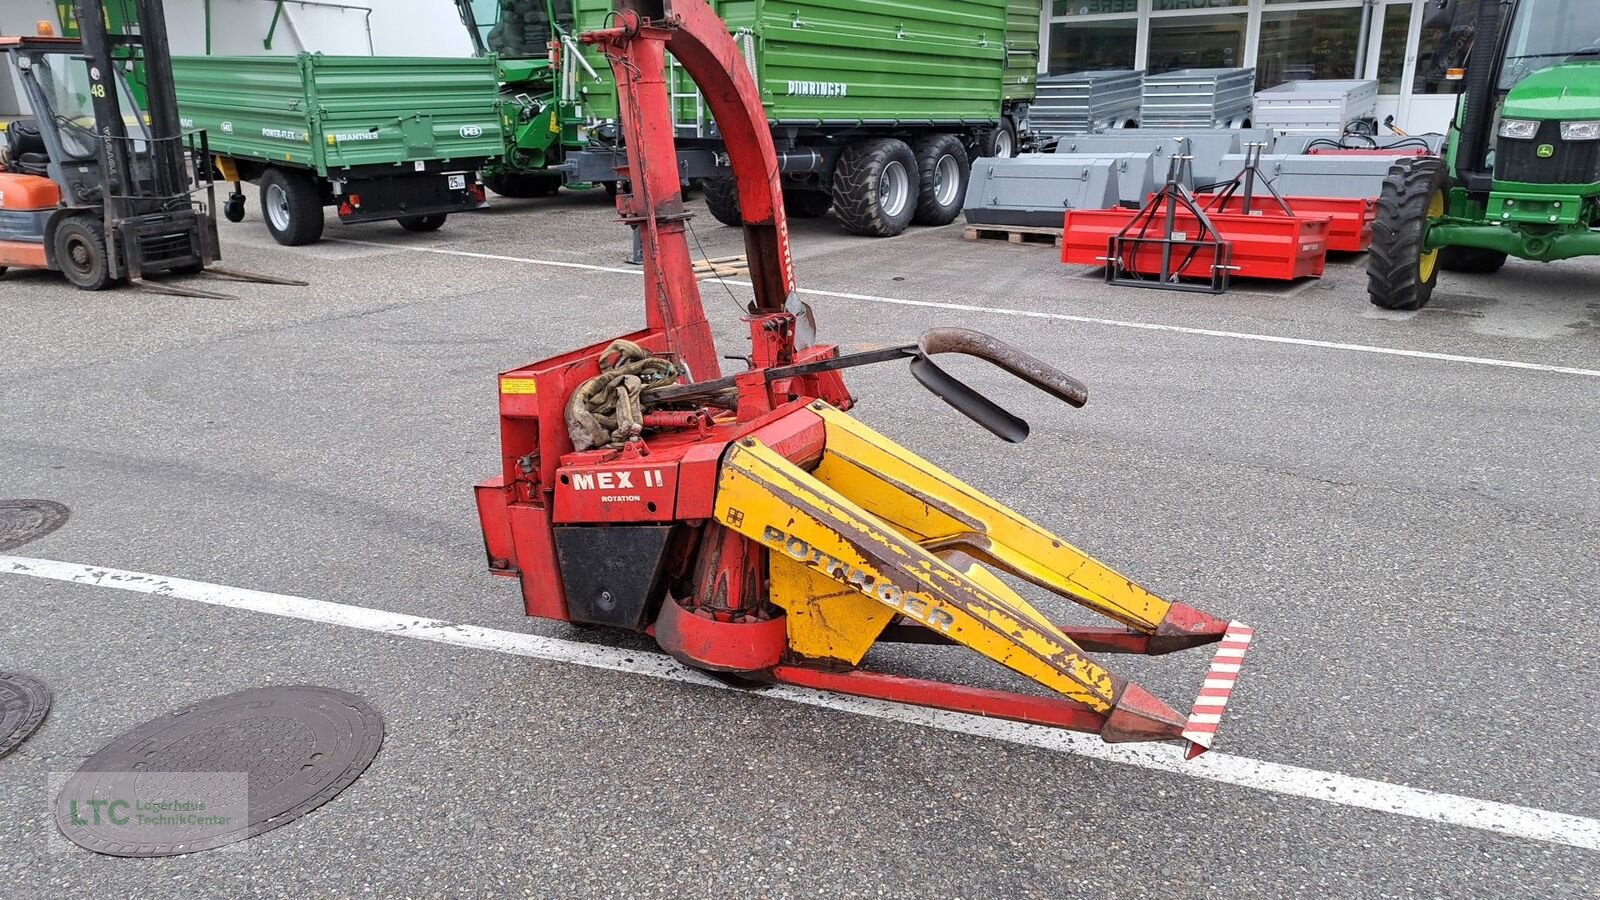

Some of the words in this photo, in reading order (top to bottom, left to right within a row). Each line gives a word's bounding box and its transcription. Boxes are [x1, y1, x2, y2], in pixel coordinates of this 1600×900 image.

[91, 84, 105, 98] 48
[335, 132, 379, 142] BRANTNER
[449, 176, 459, 189] 25
[572, 471, 634, 491] MEX
